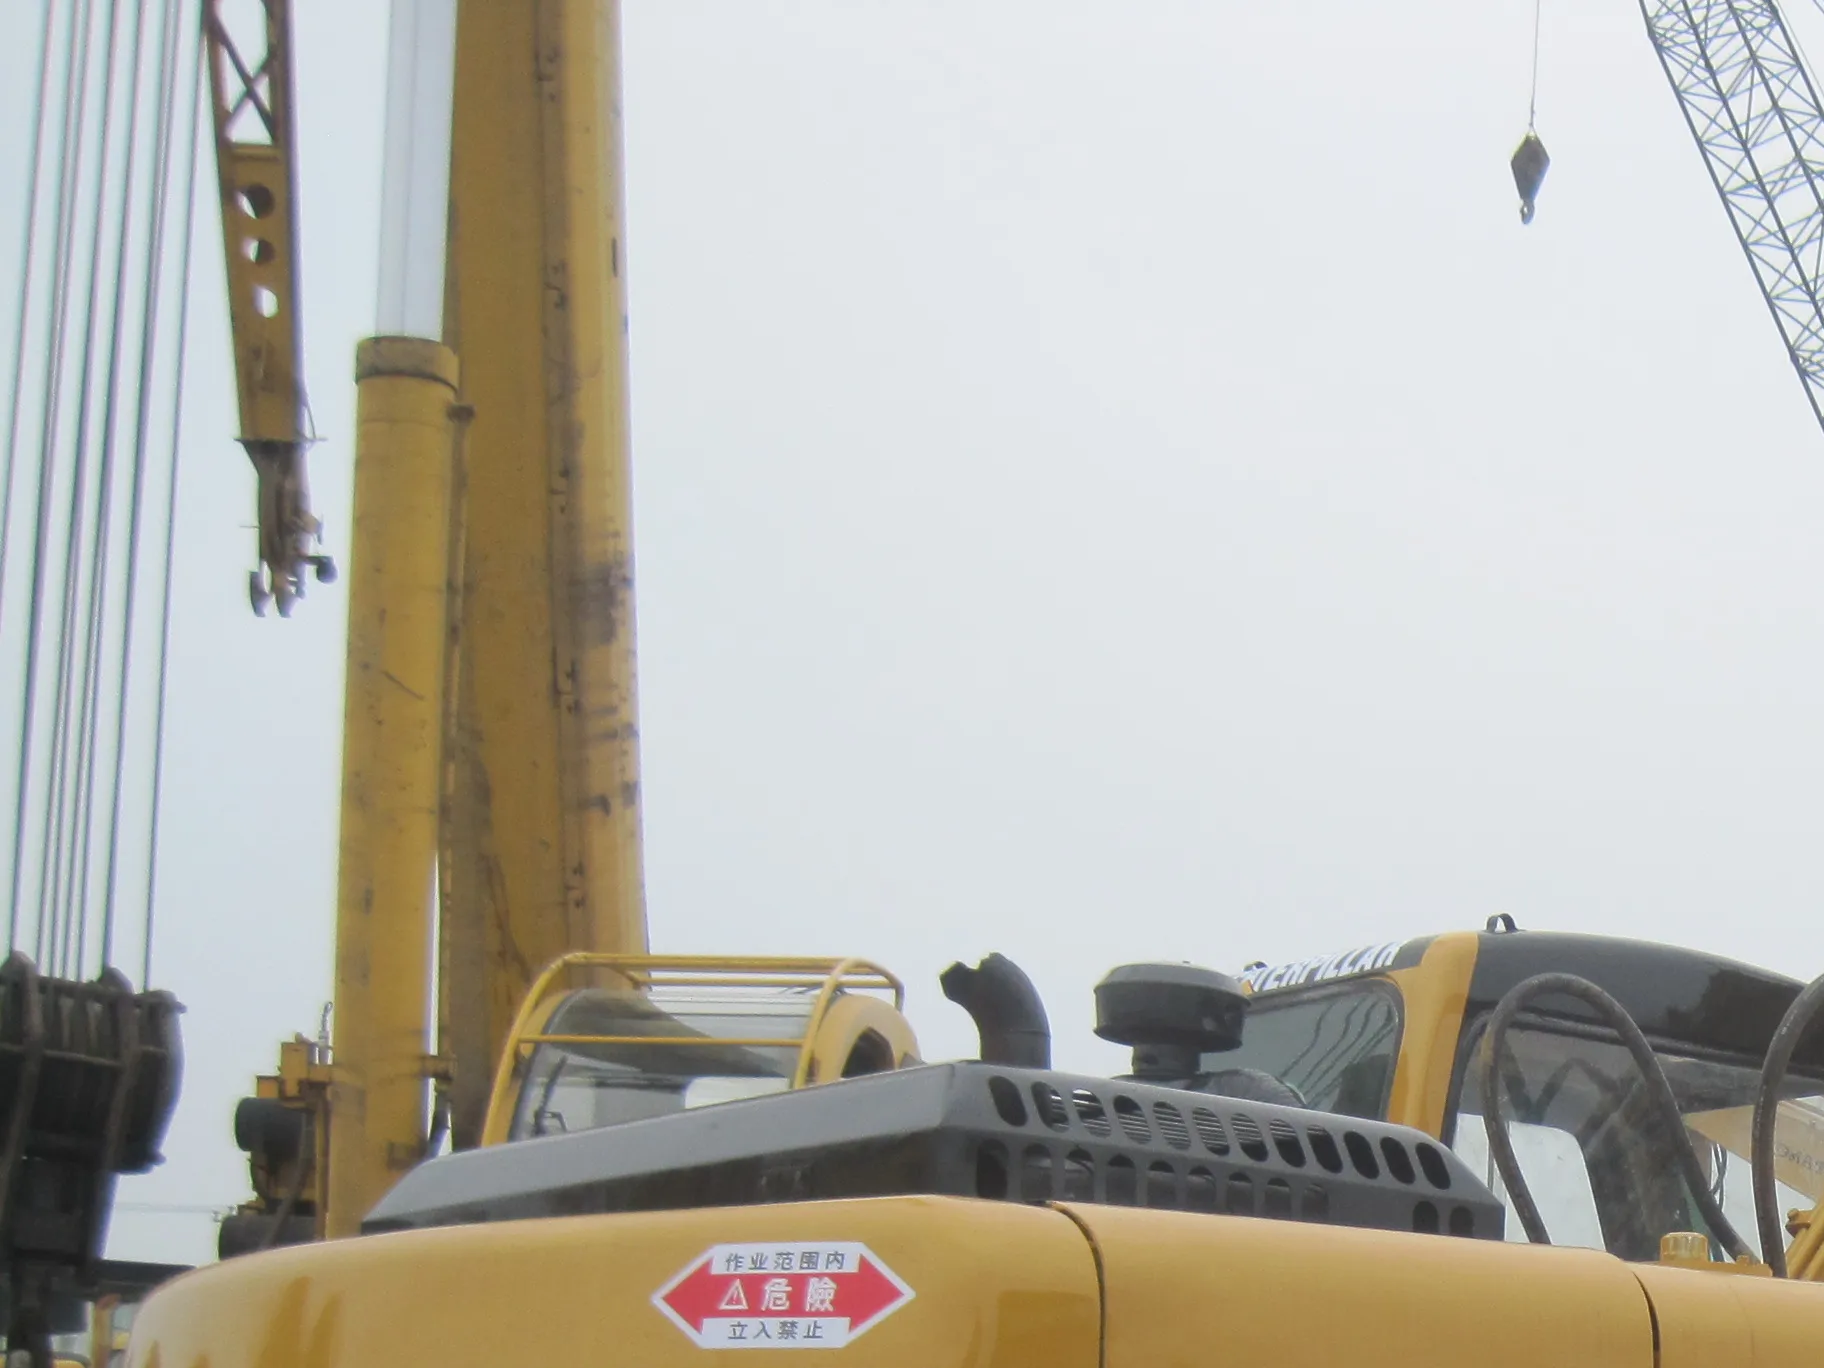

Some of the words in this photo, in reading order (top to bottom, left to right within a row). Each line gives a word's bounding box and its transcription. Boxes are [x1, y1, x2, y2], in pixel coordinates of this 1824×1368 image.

[725, 1251, 845, 1271] 作业范围内
[727, 1320, 823, 1340] 立入禁止
